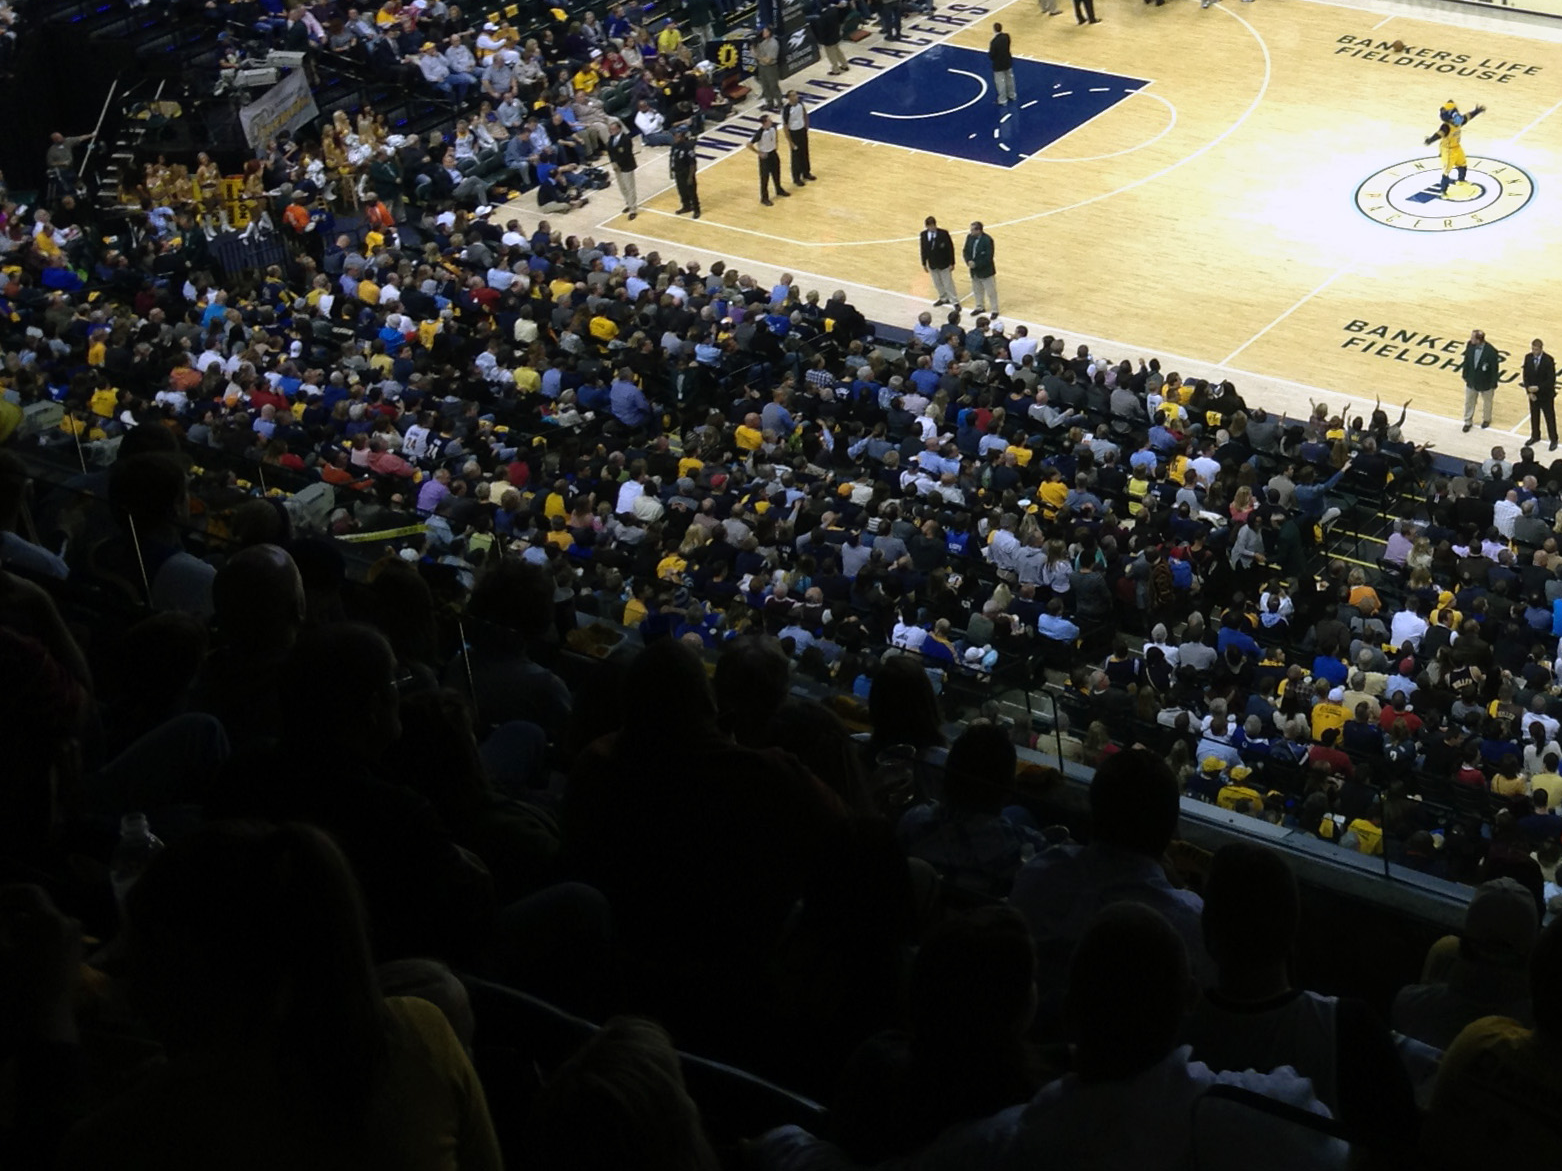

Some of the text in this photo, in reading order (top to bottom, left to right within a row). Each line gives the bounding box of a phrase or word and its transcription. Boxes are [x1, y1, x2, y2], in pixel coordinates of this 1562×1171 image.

[1335, 46, 1516, 84] FIELDHOUSE
[1336, 34, 1543, 76] BANKERS LIFE
